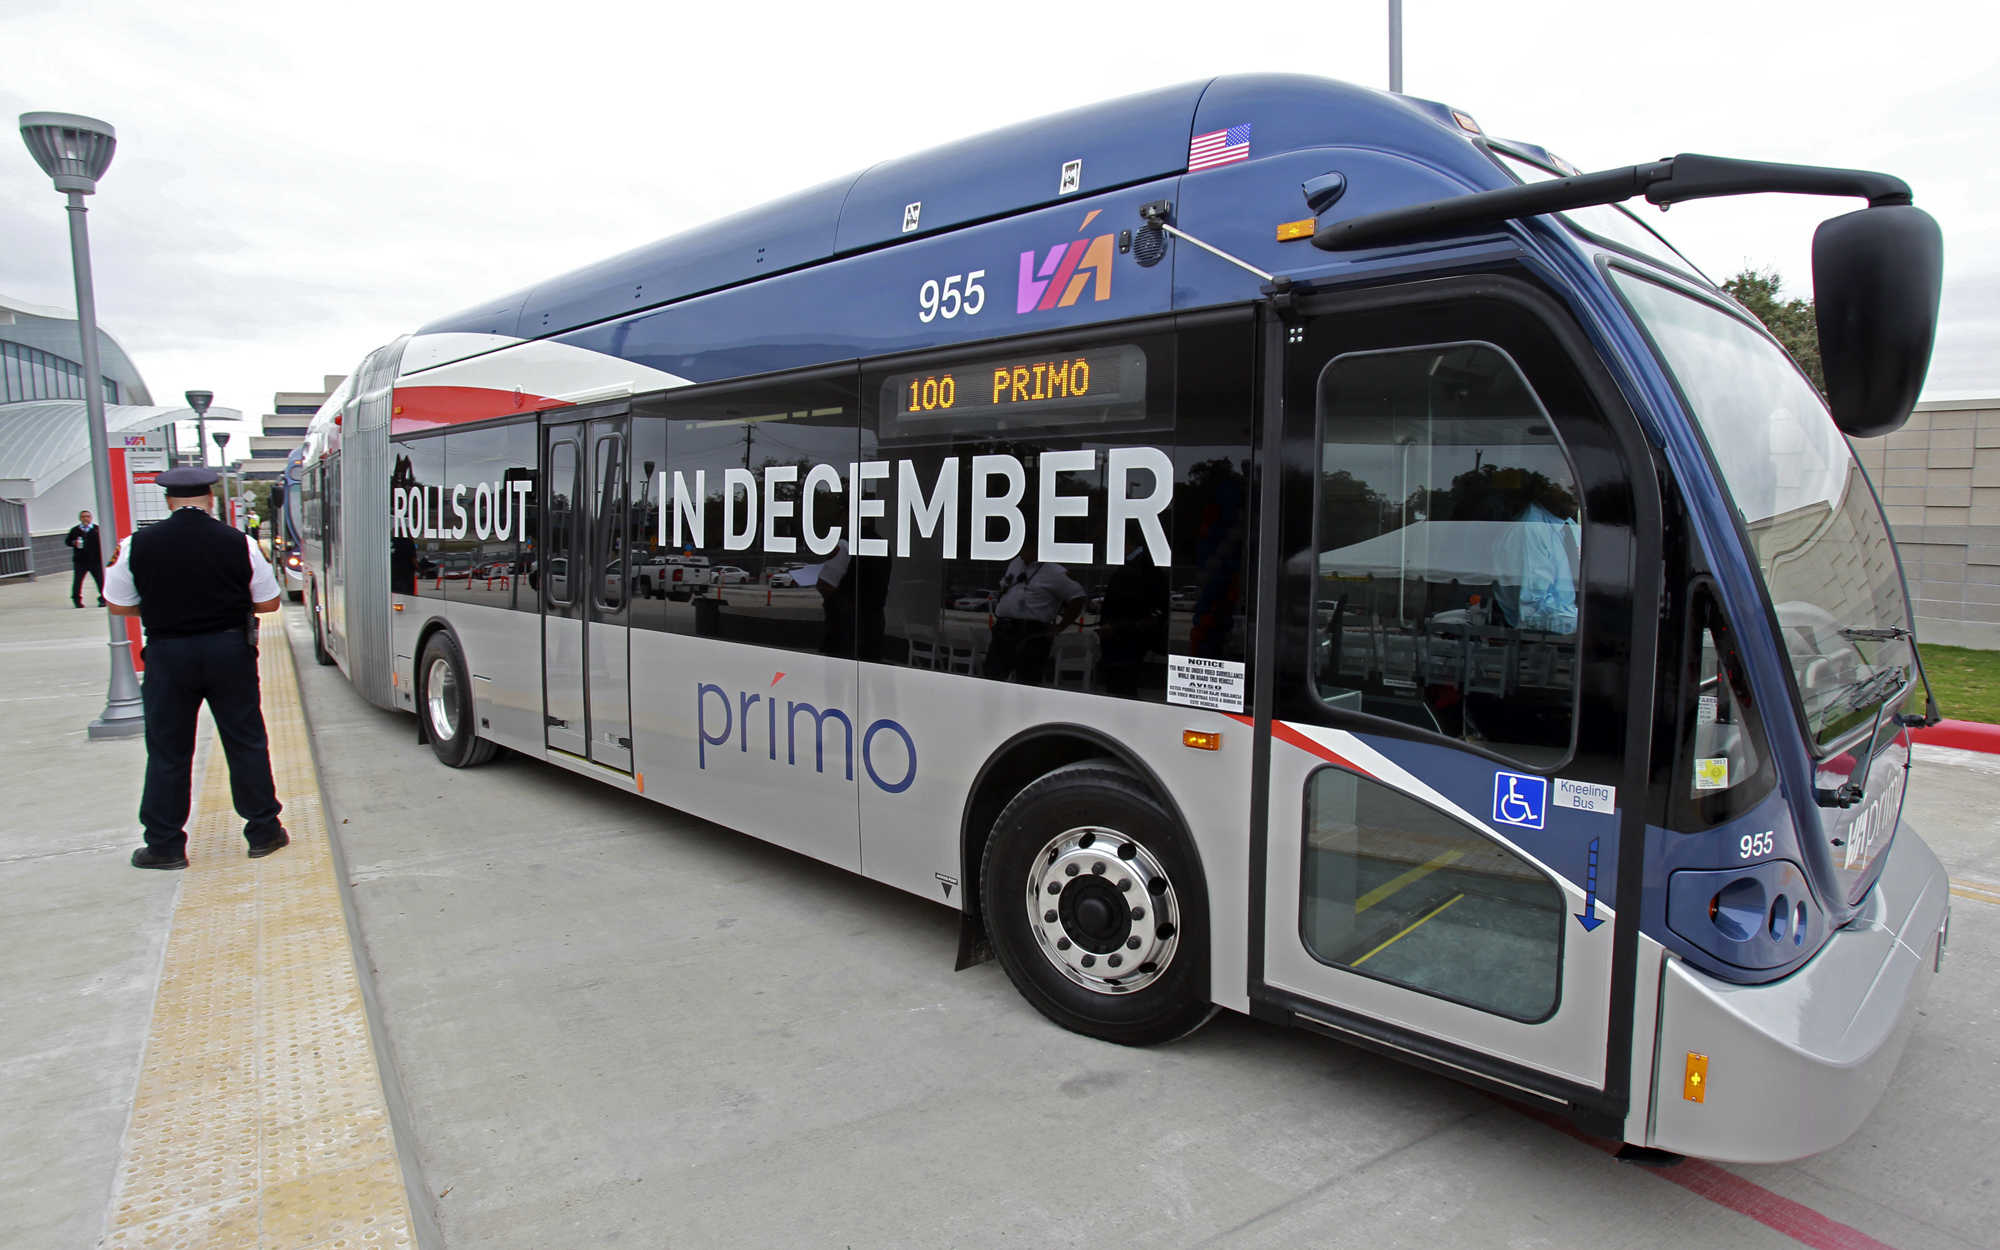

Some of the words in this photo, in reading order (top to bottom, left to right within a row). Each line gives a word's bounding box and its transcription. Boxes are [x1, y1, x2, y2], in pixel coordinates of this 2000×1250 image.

[918, 269, 986, 323] 955
[910, 378, 955, 411] 100
[993, 358, 1089, 403] PRIMO
[393, 483, 467, 540] ROLLS
[474, 480, 533, 542] OUT
[658, 469, 706, 549] IN
[724, 446, 1174, 567] DECEMBER
[1188, 659, 1225, 668] NOTICE
[1196, 674, 1208, 682] BOARD
[1219, 677, 1234, 686] VEHICLE
[1217, 671, 1243, 679] SURVEILLANCE
[1189, 682, 1221, 690] AVISO
[1560, 780, 1609, 801] Kneeling
[1573, 795, 1594, 810] Bus
[1739, 830, 1774, 859] 955
